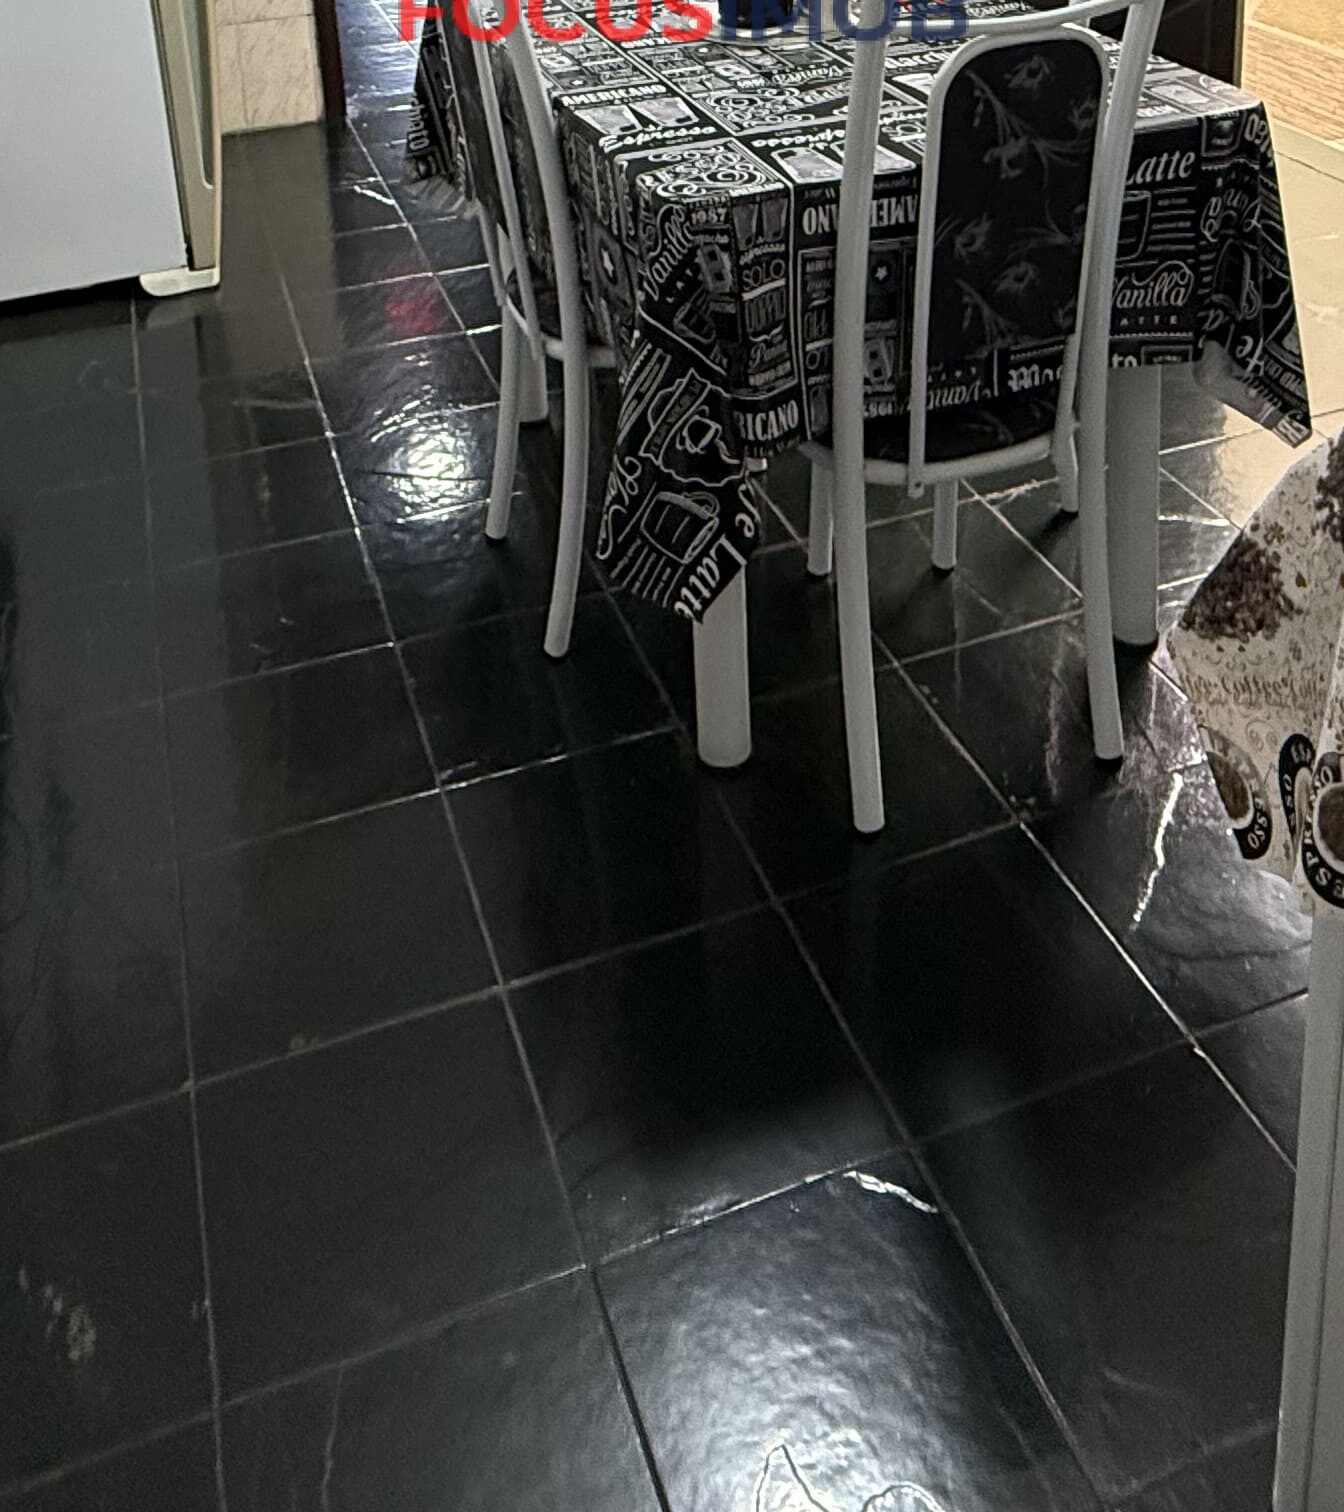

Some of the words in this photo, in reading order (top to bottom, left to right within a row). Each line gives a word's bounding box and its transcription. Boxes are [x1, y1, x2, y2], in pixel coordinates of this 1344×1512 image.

[560, 85, 668, 106] AMERICANO
[691, 208, 727, 225] 1987
[742, 258, 786, 290] SOLO
